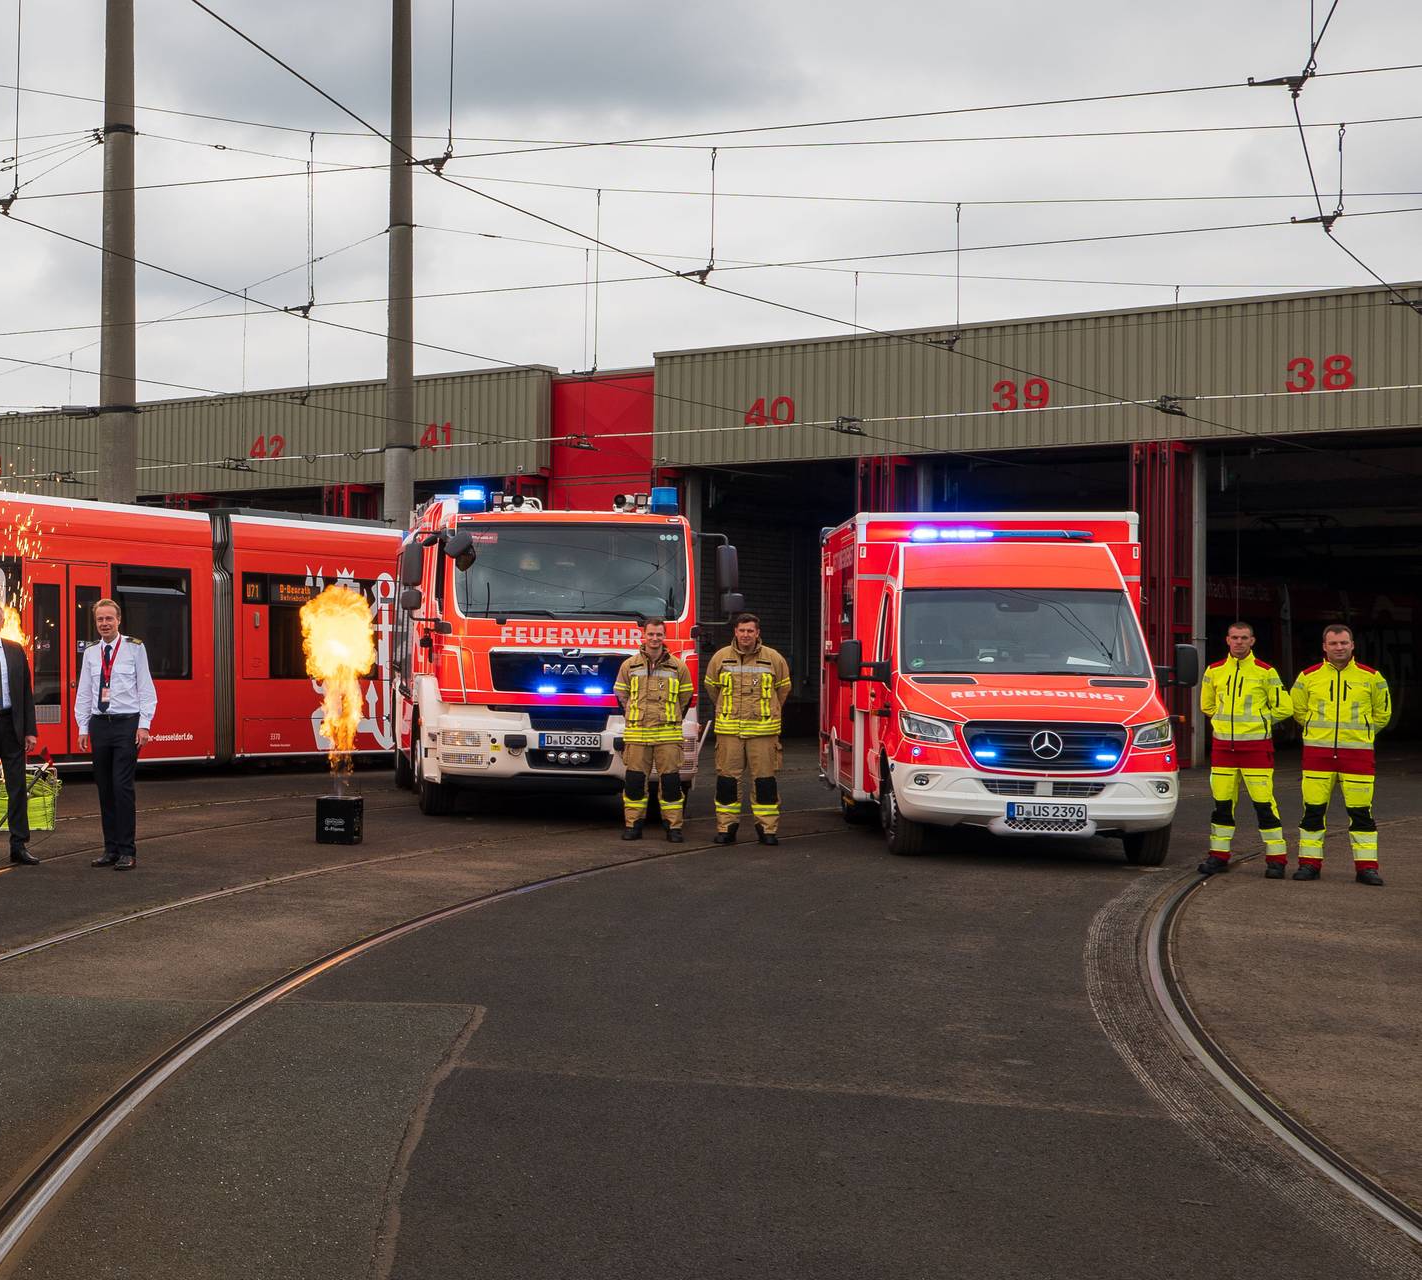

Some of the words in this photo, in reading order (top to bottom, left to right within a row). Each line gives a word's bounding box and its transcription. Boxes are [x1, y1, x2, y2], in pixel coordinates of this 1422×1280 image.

[1286, 355, 1354, 392] 38
[993, 378, 1049, 411] 39
[745, 396, 795, 426] 40
[420, 422, 452, 449] 41
[250, 435, 285, 459] 42
[246, 583, 259, 598] U71
[500, 626, 643, 646] FEUERWEHR
[543, 663, 599, 677] MAN
[950, 690, 1126, 702] RETTUNGSDIENST
[546, 735, 553, 745] D
[559, 735, 572, 745] US
[573, 735, 599, 746] 2836
[1016, 805, 1024, 816] D
[1033, 805, 1050, 817] US
[1052, 806, 1084, 818] 2396
